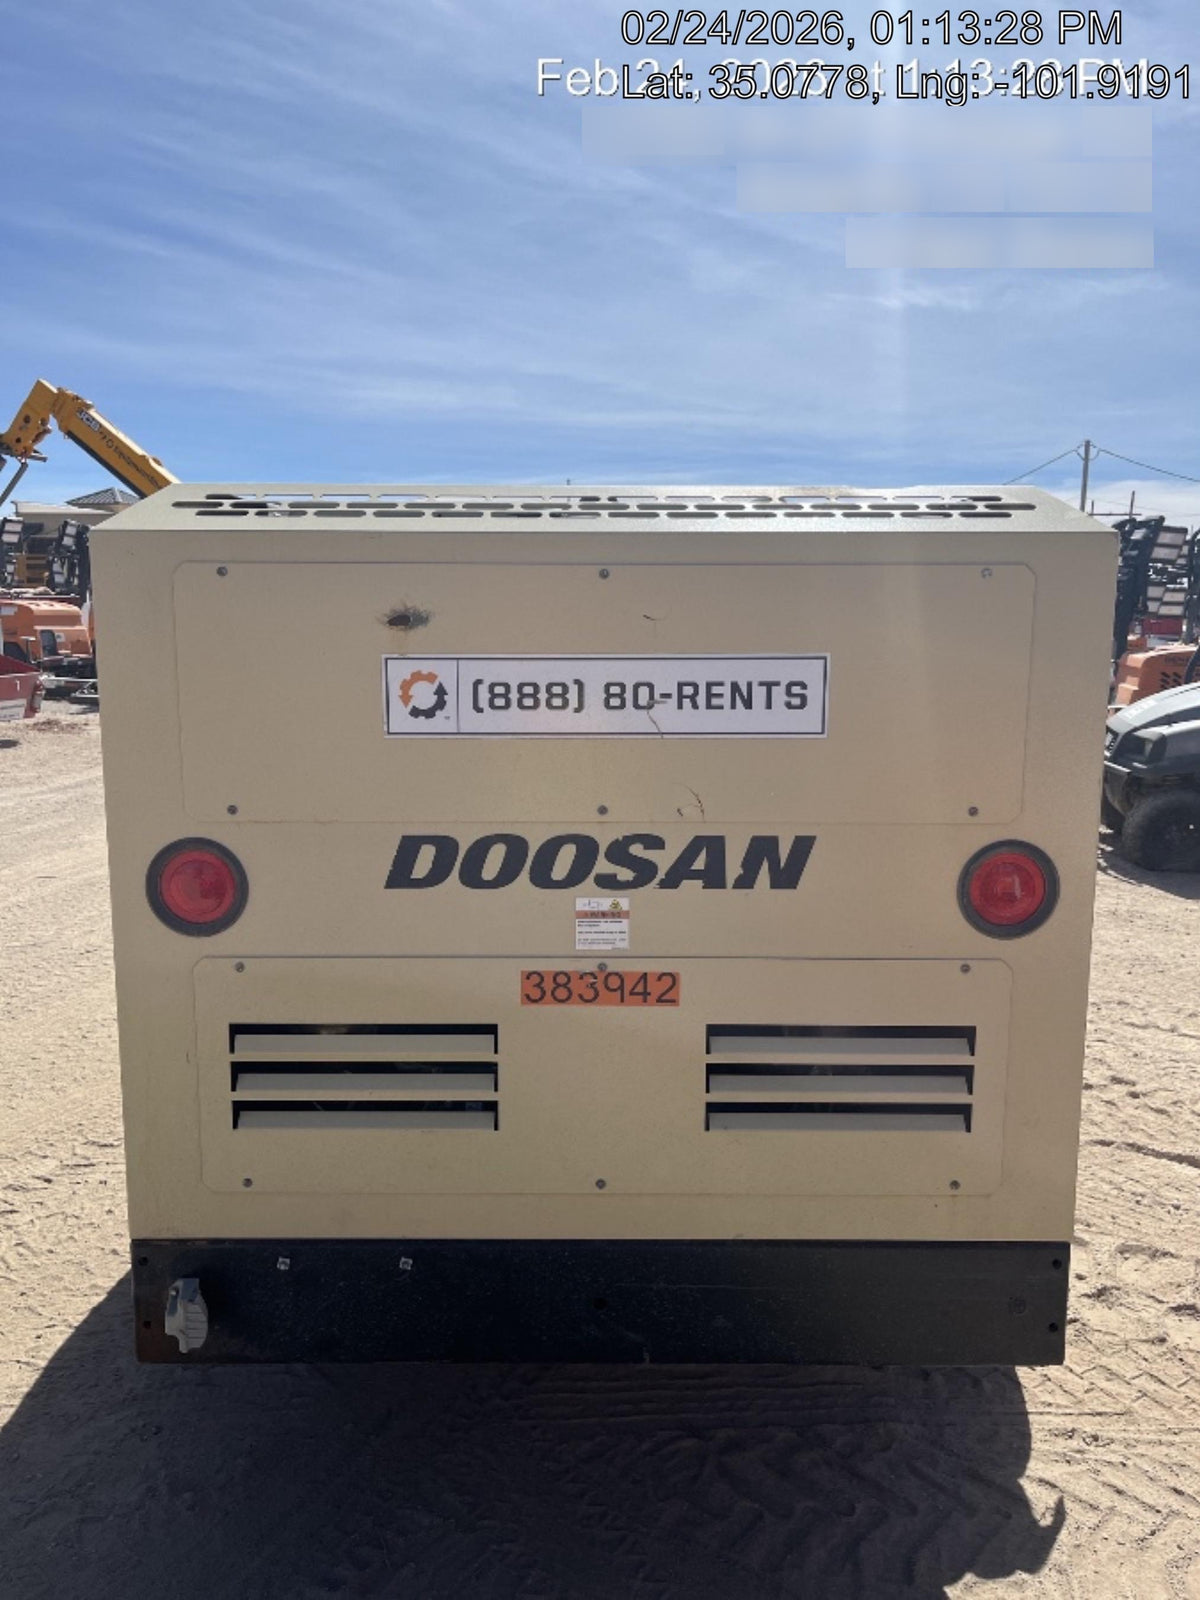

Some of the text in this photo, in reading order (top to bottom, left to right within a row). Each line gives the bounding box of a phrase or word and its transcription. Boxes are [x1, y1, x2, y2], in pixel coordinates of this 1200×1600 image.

[472, 679, 809, 713] (888) 80-RENTS
[384, 834, 817, 890] DOOSAN
[523, 972, 678, 1004] 383942
